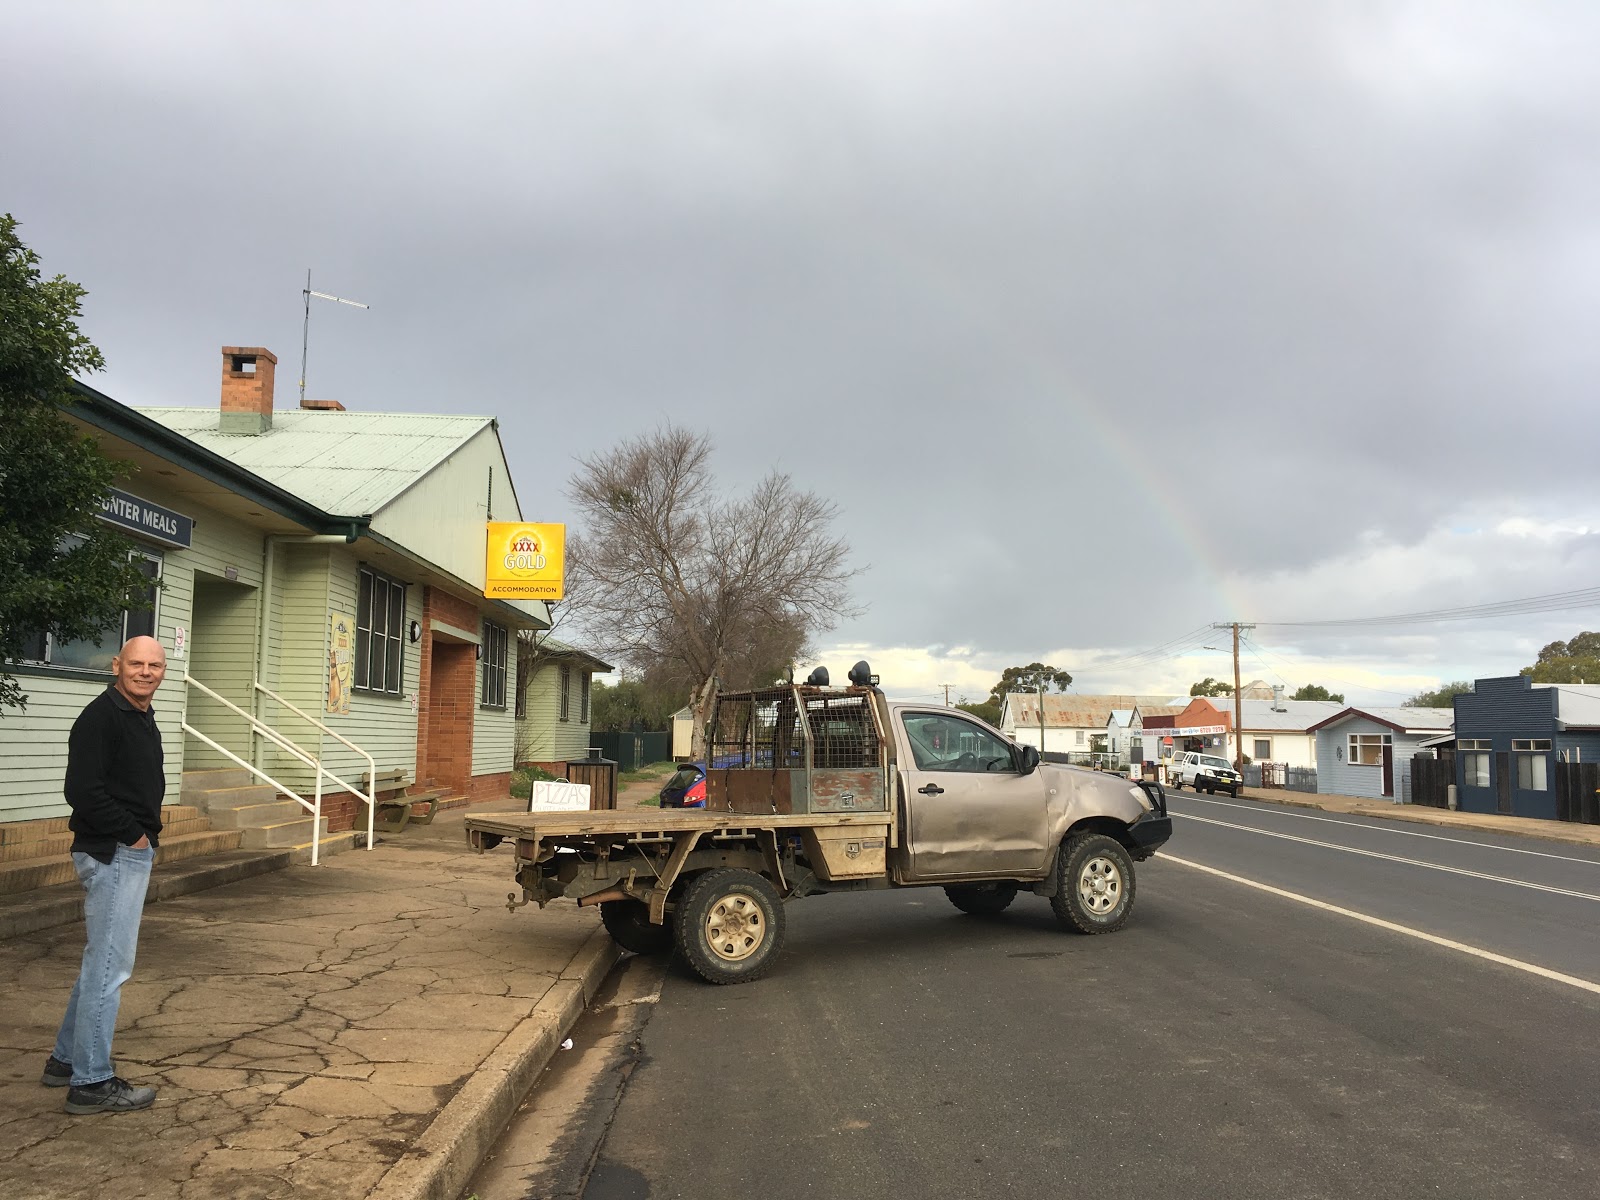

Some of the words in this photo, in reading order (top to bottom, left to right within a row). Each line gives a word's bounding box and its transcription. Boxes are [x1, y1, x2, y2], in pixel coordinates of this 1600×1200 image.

[97, 495, 140, 523] UNTER
[142, 508, 177, 536] MEALS
[511, 542, 540, 552] XXXX
[503, 553, 547, 570] GOLD
